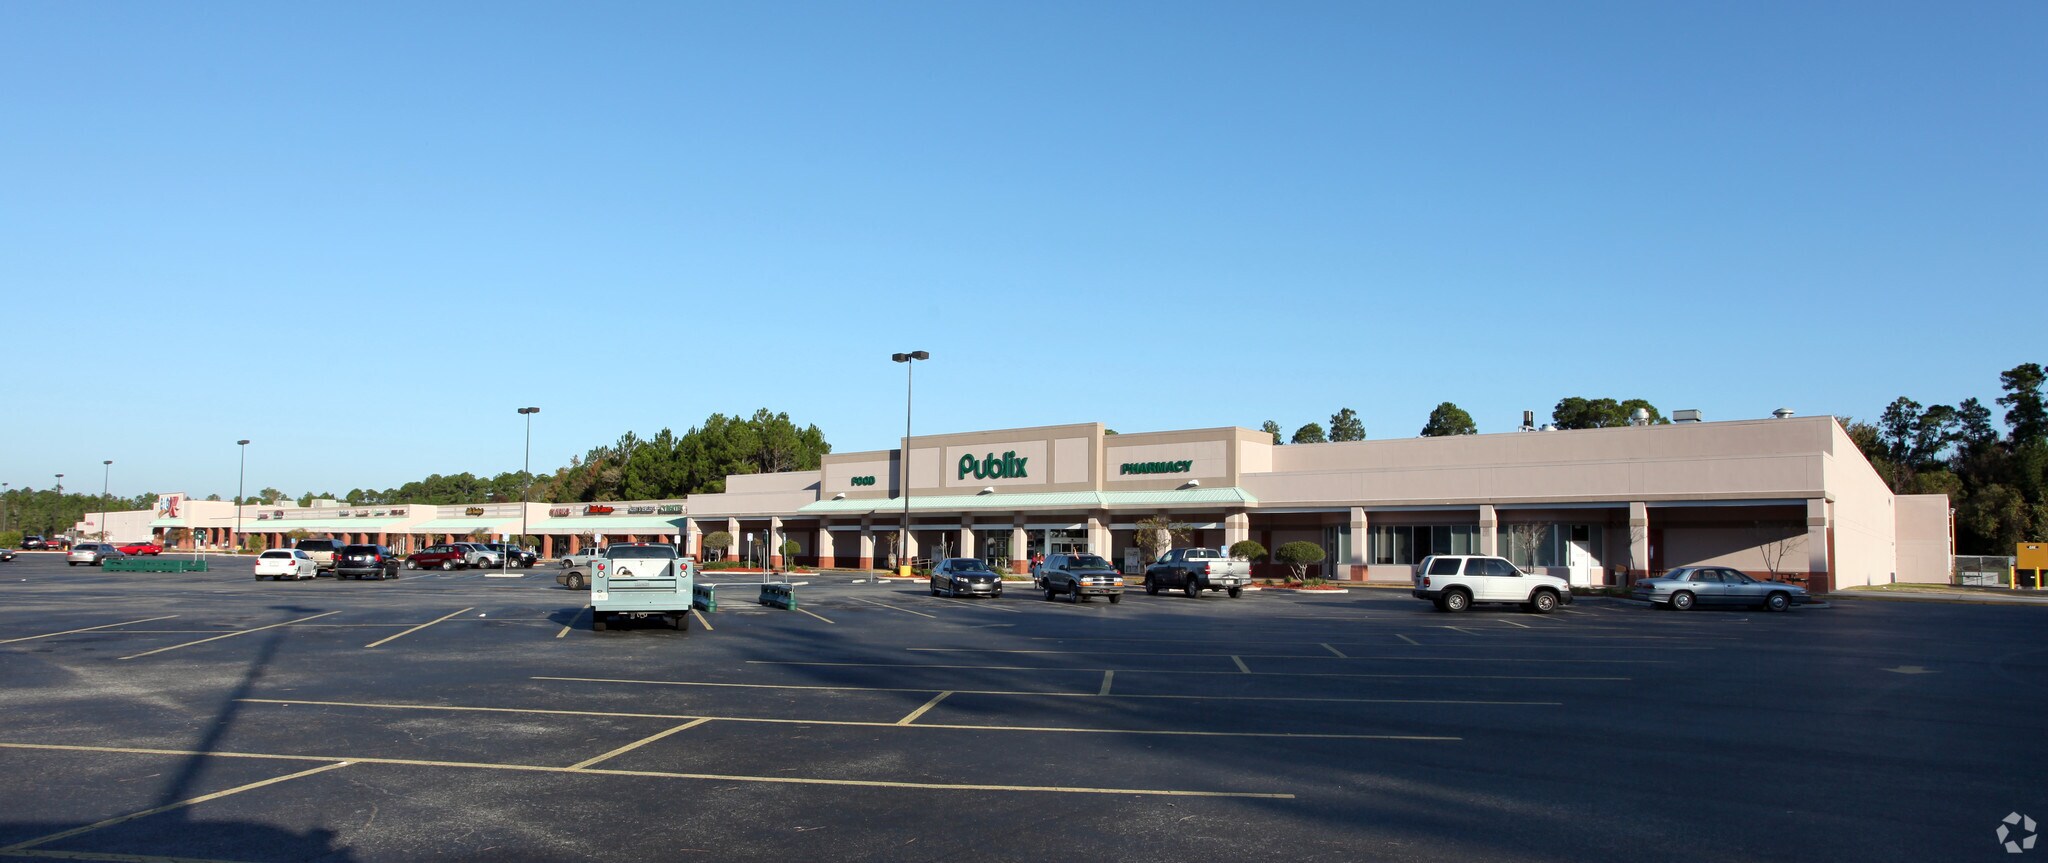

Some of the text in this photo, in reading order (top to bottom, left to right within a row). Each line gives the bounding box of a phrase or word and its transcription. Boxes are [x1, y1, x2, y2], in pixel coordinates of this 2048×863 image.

[958, 450, 1028, 480] Publix
[1120, 460, 1193, 475] PHARMACY
[851, 476, 875, 486] FOOD
